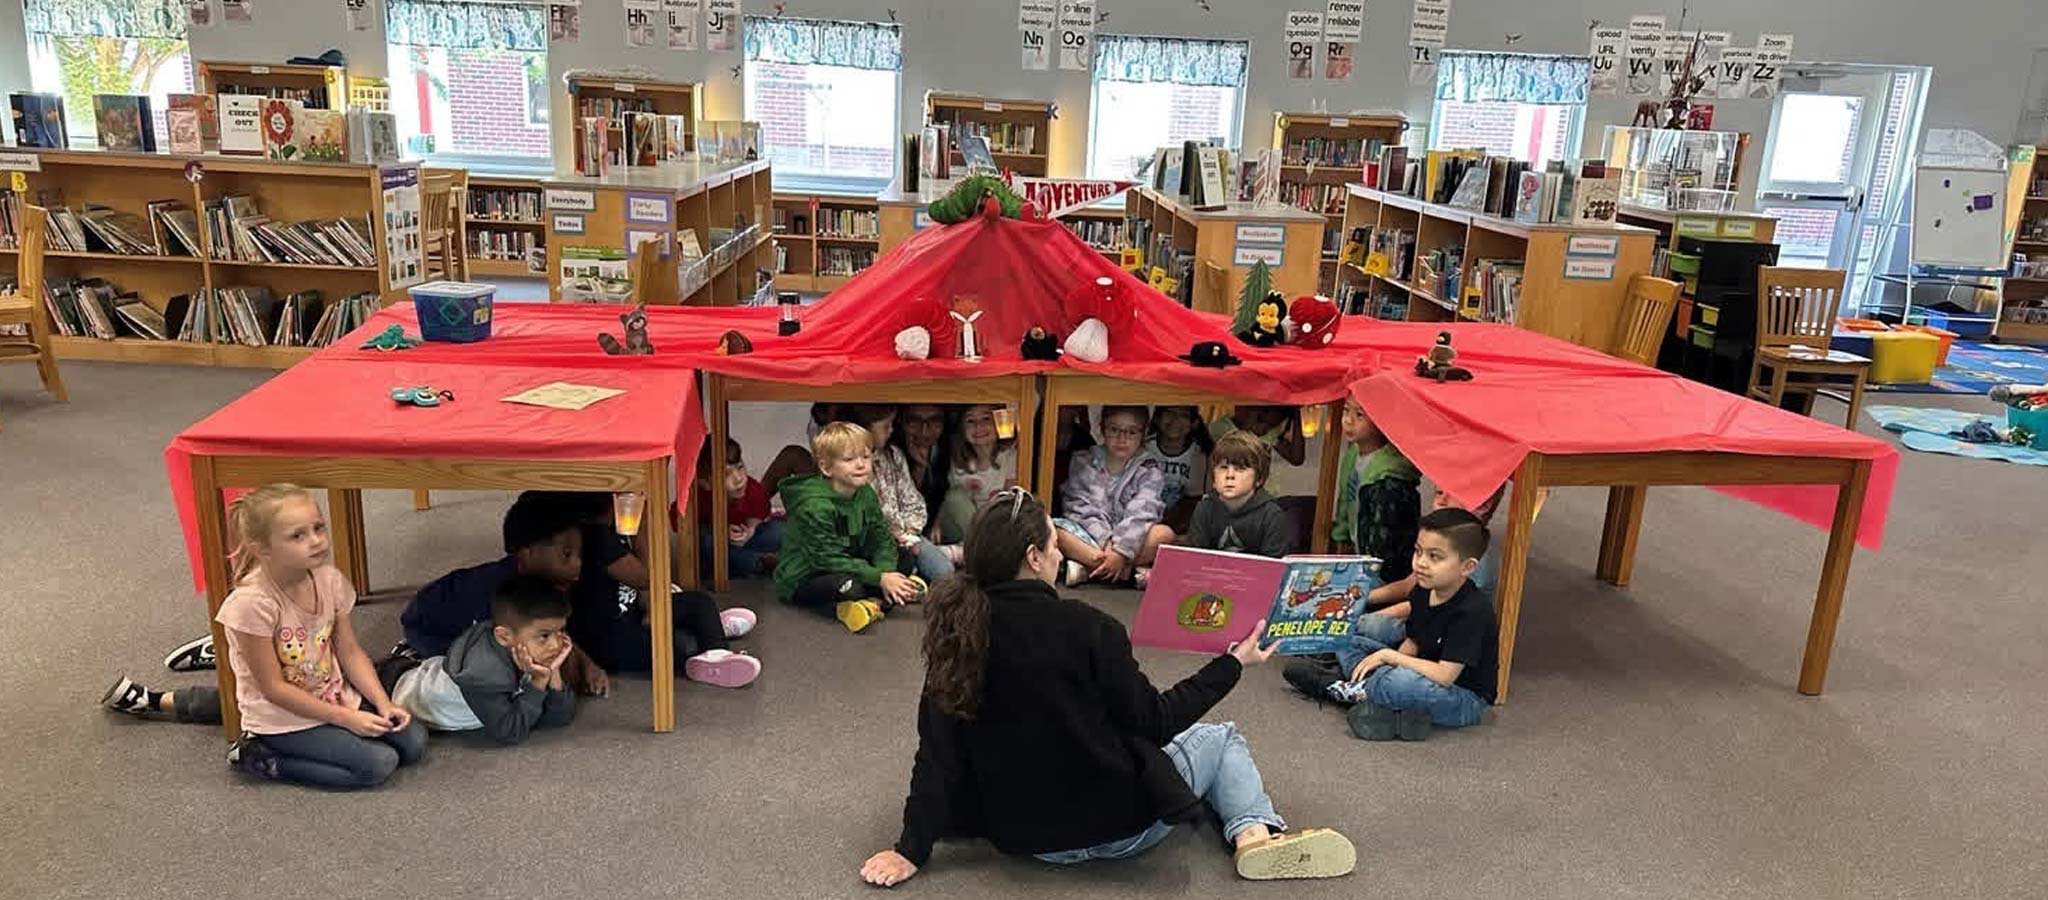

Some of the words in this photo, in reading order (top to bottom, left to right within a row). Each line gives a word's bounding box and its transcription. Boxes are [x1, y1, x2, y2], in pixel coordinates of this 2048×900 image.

[1063, 4, 1091, 13] online
[1329, 2, 1361, 12] renew
[627, 8, 647, 24] Hh
[708, 12, 723, 30] Jj
[1290, 15, 1319, 26] quote
[1328, 17, 1360, 26] reliable
[1024, 31, 1044, 45] Nn
[1063, 31, 1085, 46] Oo
[1286, 29, 1320, 38] question
[1596, 31, 1622, 39] upload
[1630, 33, 1661, 41] visualize
[1328, 42, 1345, 56] Rr
[1764, 38, 1786, 46] Zoom
[1290, 41, 1313, 59] Qq
[1414, 46, 1430, 61] Tt
[1598, 45, 1616, 54] URL
[1631, 47, 1656, 57] verify
[1594, 56, 1613, 70] Uu
[1757, 53, 1769, 61] zip
[1629, 58, 1653, 75] Vv
[1724, 62, 1743, 81] Yy
[1753, 62, 1775, 80] Zz
[228, 109, 258, 117] CHECK
[11, 171, 28, 192] B
[551, 196, 586, 206] Everybody
[1023, 181, 1111, 213] ADVENTURE
[1266, 619, 1328, 638] PENELOPE
[1328, 619, 1352, 636] REX
